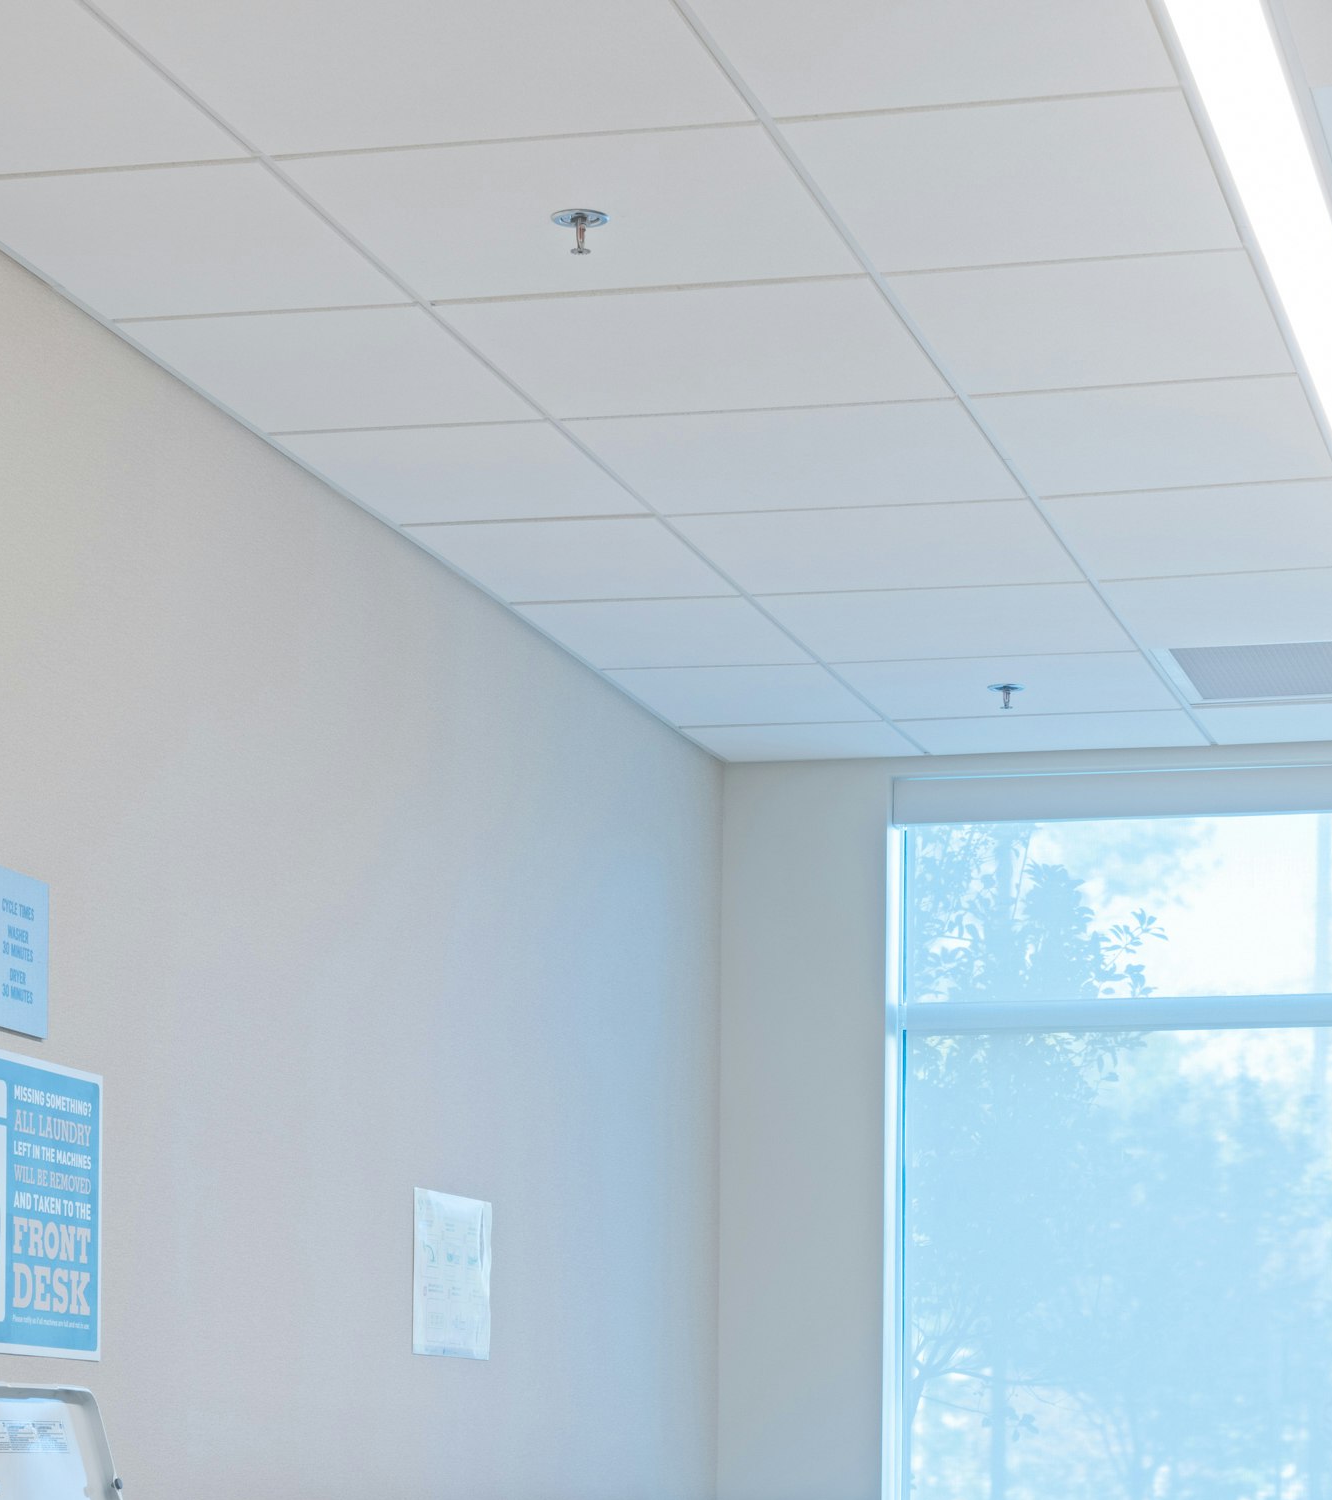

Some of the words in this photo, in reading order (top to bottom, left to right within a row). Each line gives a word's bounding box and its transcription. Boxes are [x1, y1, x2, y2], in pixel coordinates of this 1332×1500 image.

[2, 898, 18, 915] CYCLE
[19, 903, 34, 921] TIMES
[7, 924, 29, 945] WASHER
[2, 940, 10, 955] 30
[10, 943, 33, 963] MINUTES
[9, 967, 26, 985] DRYER
[2, 983, 10, 998] 30
[10, 986, 33, 1005] MINUTES
[14, 1084, 45, 1106] MISSING
[46, 1092, 92, 1118] SOMETHING?
[14, 1109, 36, 1135] ALL
[38, 1114, 92, 1147] LAUNDRY
[13, 1140, 31, 1158] LEFT
[32, 1144, 40, 1160] IN
[41, 1146, 55, 1163] THE
[56, 1150, 92, 1170] MACHINES
[14, 1163, 35, 1185] WILL
[37, 1168, 47, 1187] BE
[50, 1171, 91, 1195] REMOVED
[13, 1190, 32, 1210] AND
[33, 1194, 61, 1215] TAKEN
[63, 1199, 74, 1218] TO
[75, 1201, 91, 1221] THE
[12, 1215, 91, 1264] FRONT
[12, 1262, 91, 1316] DESK
